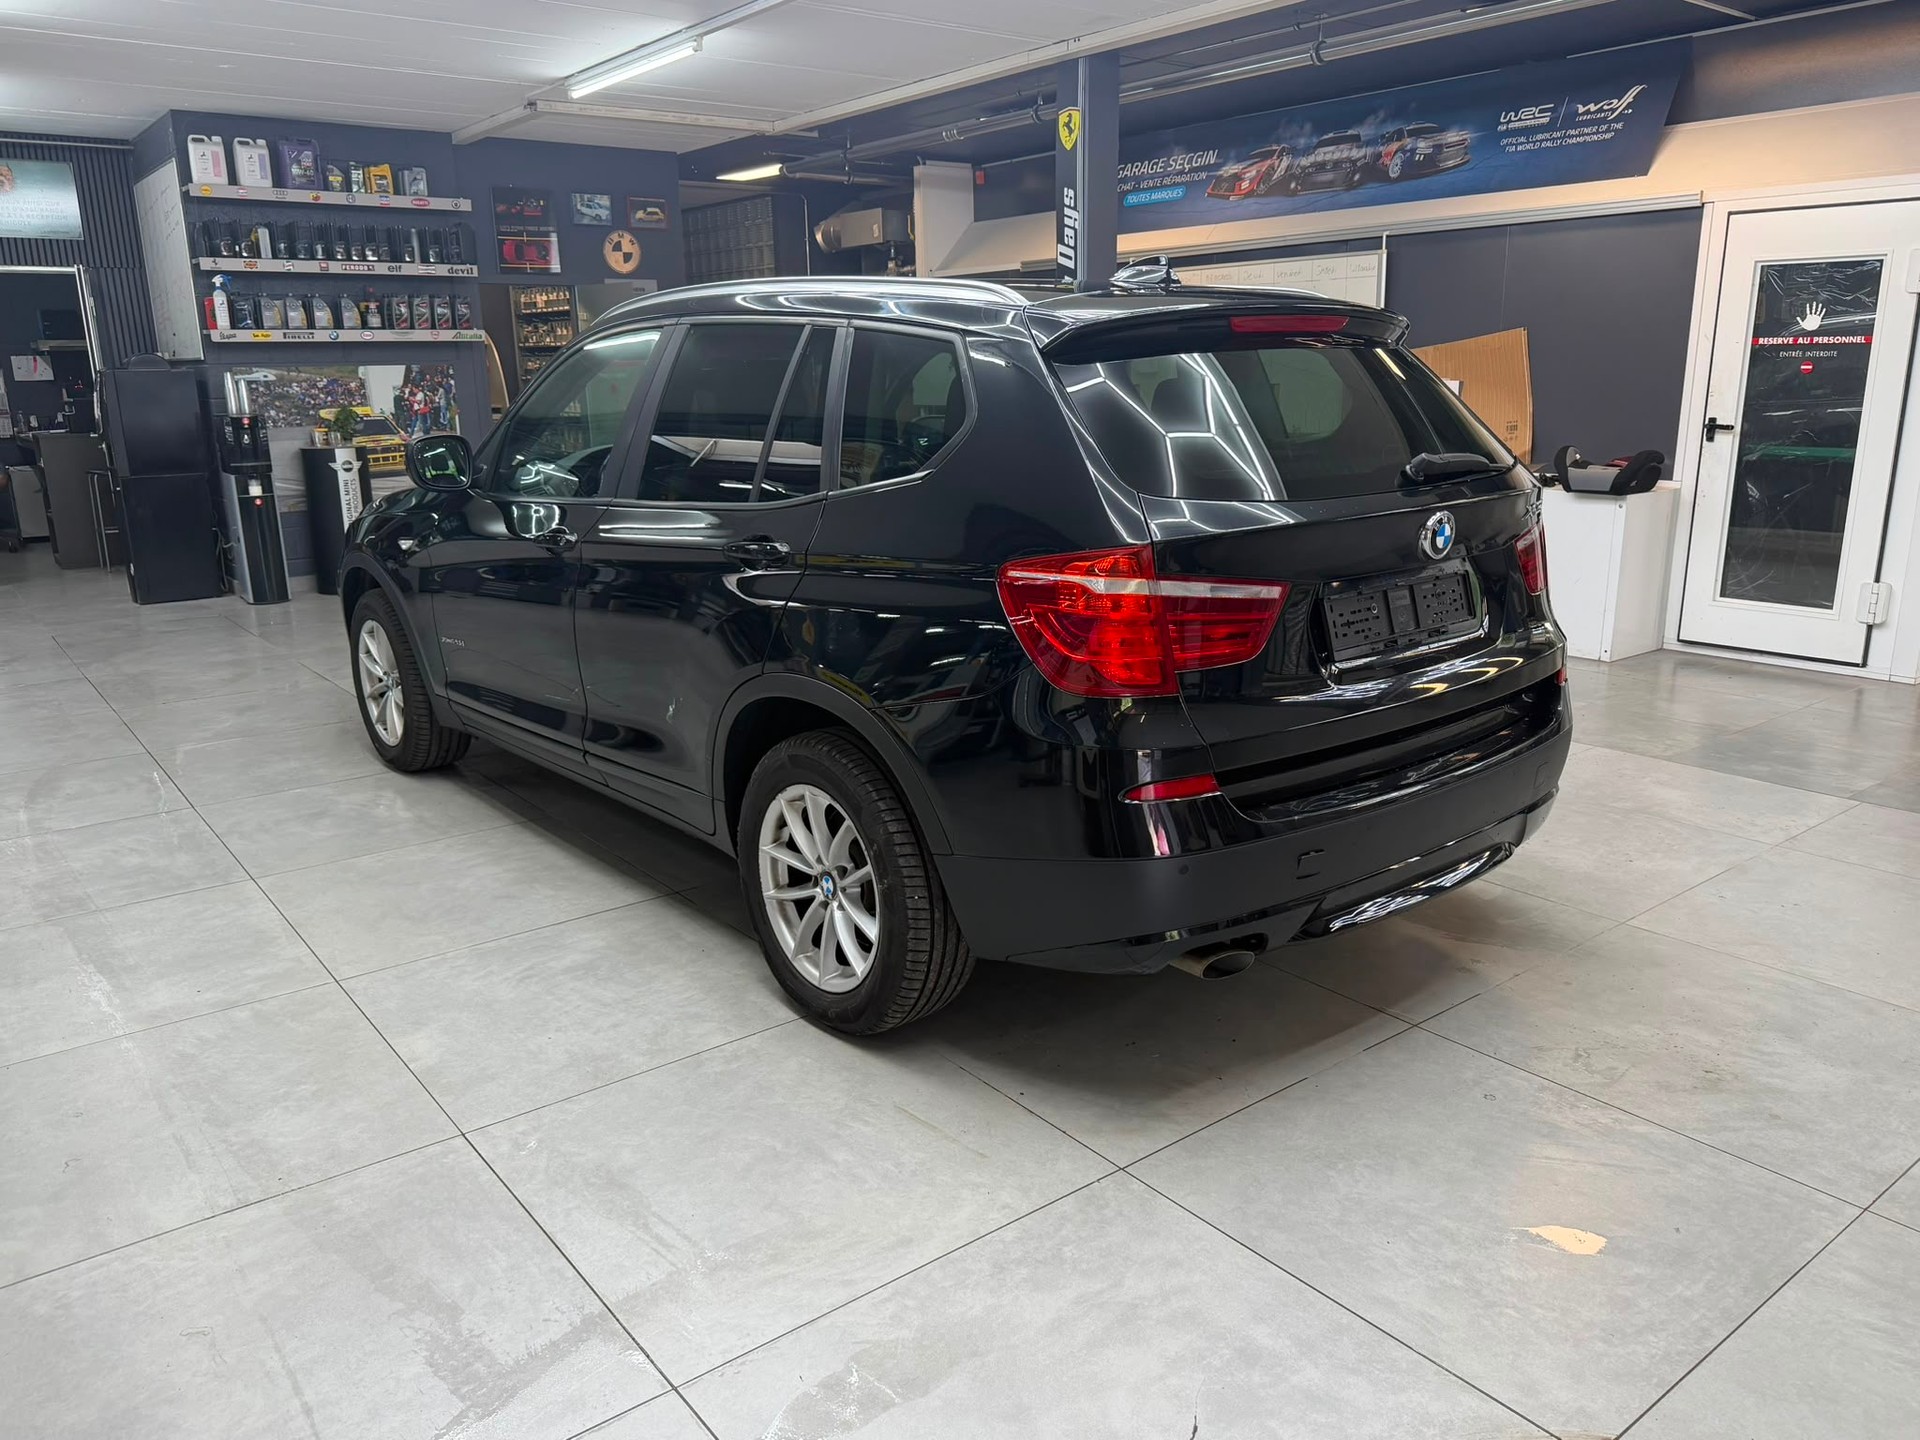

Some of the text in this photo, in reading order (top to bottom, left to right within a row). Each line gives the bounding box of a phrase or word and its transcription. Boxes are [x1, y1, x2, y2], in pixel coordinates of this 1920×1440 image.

[1499, 103, 1555, 123] WRC
[1575, 111, 1612, 122] LUBRICANTS
[1500, 135, 1527, 146] OFFICIAL
[1528, 130, 1566, 142] LUBRICANT
[1566, 126, 1600, 137] PARTNER
[1610, 121, 1625, 130] THE
[1505, 132, 1615, 153] FIA WORLD RALLY CHAMPIONSHIP
[1166, 149, 1218, 172] SEÇGIN
[1117, 181, 1135, 192] CHAT
[1140, 179, 1162, 189] VENTE
[1162, 171, 1208, 185] RÉPARATION
[1126, 188, 1184, 203] TOUTES MARQUES
[1057, 187, 1079, 270] Days
[387, 264, 402, 273] elf
[447, 266, 474, 275] devil
[1758, 336, 1794, 345] RESERVE
[1812, 335, 1866, 344] PERSONNEL
[1779, 350, 1803, 358] ENTRÉE
[349, 478, 359, 513] PRODUCTS
